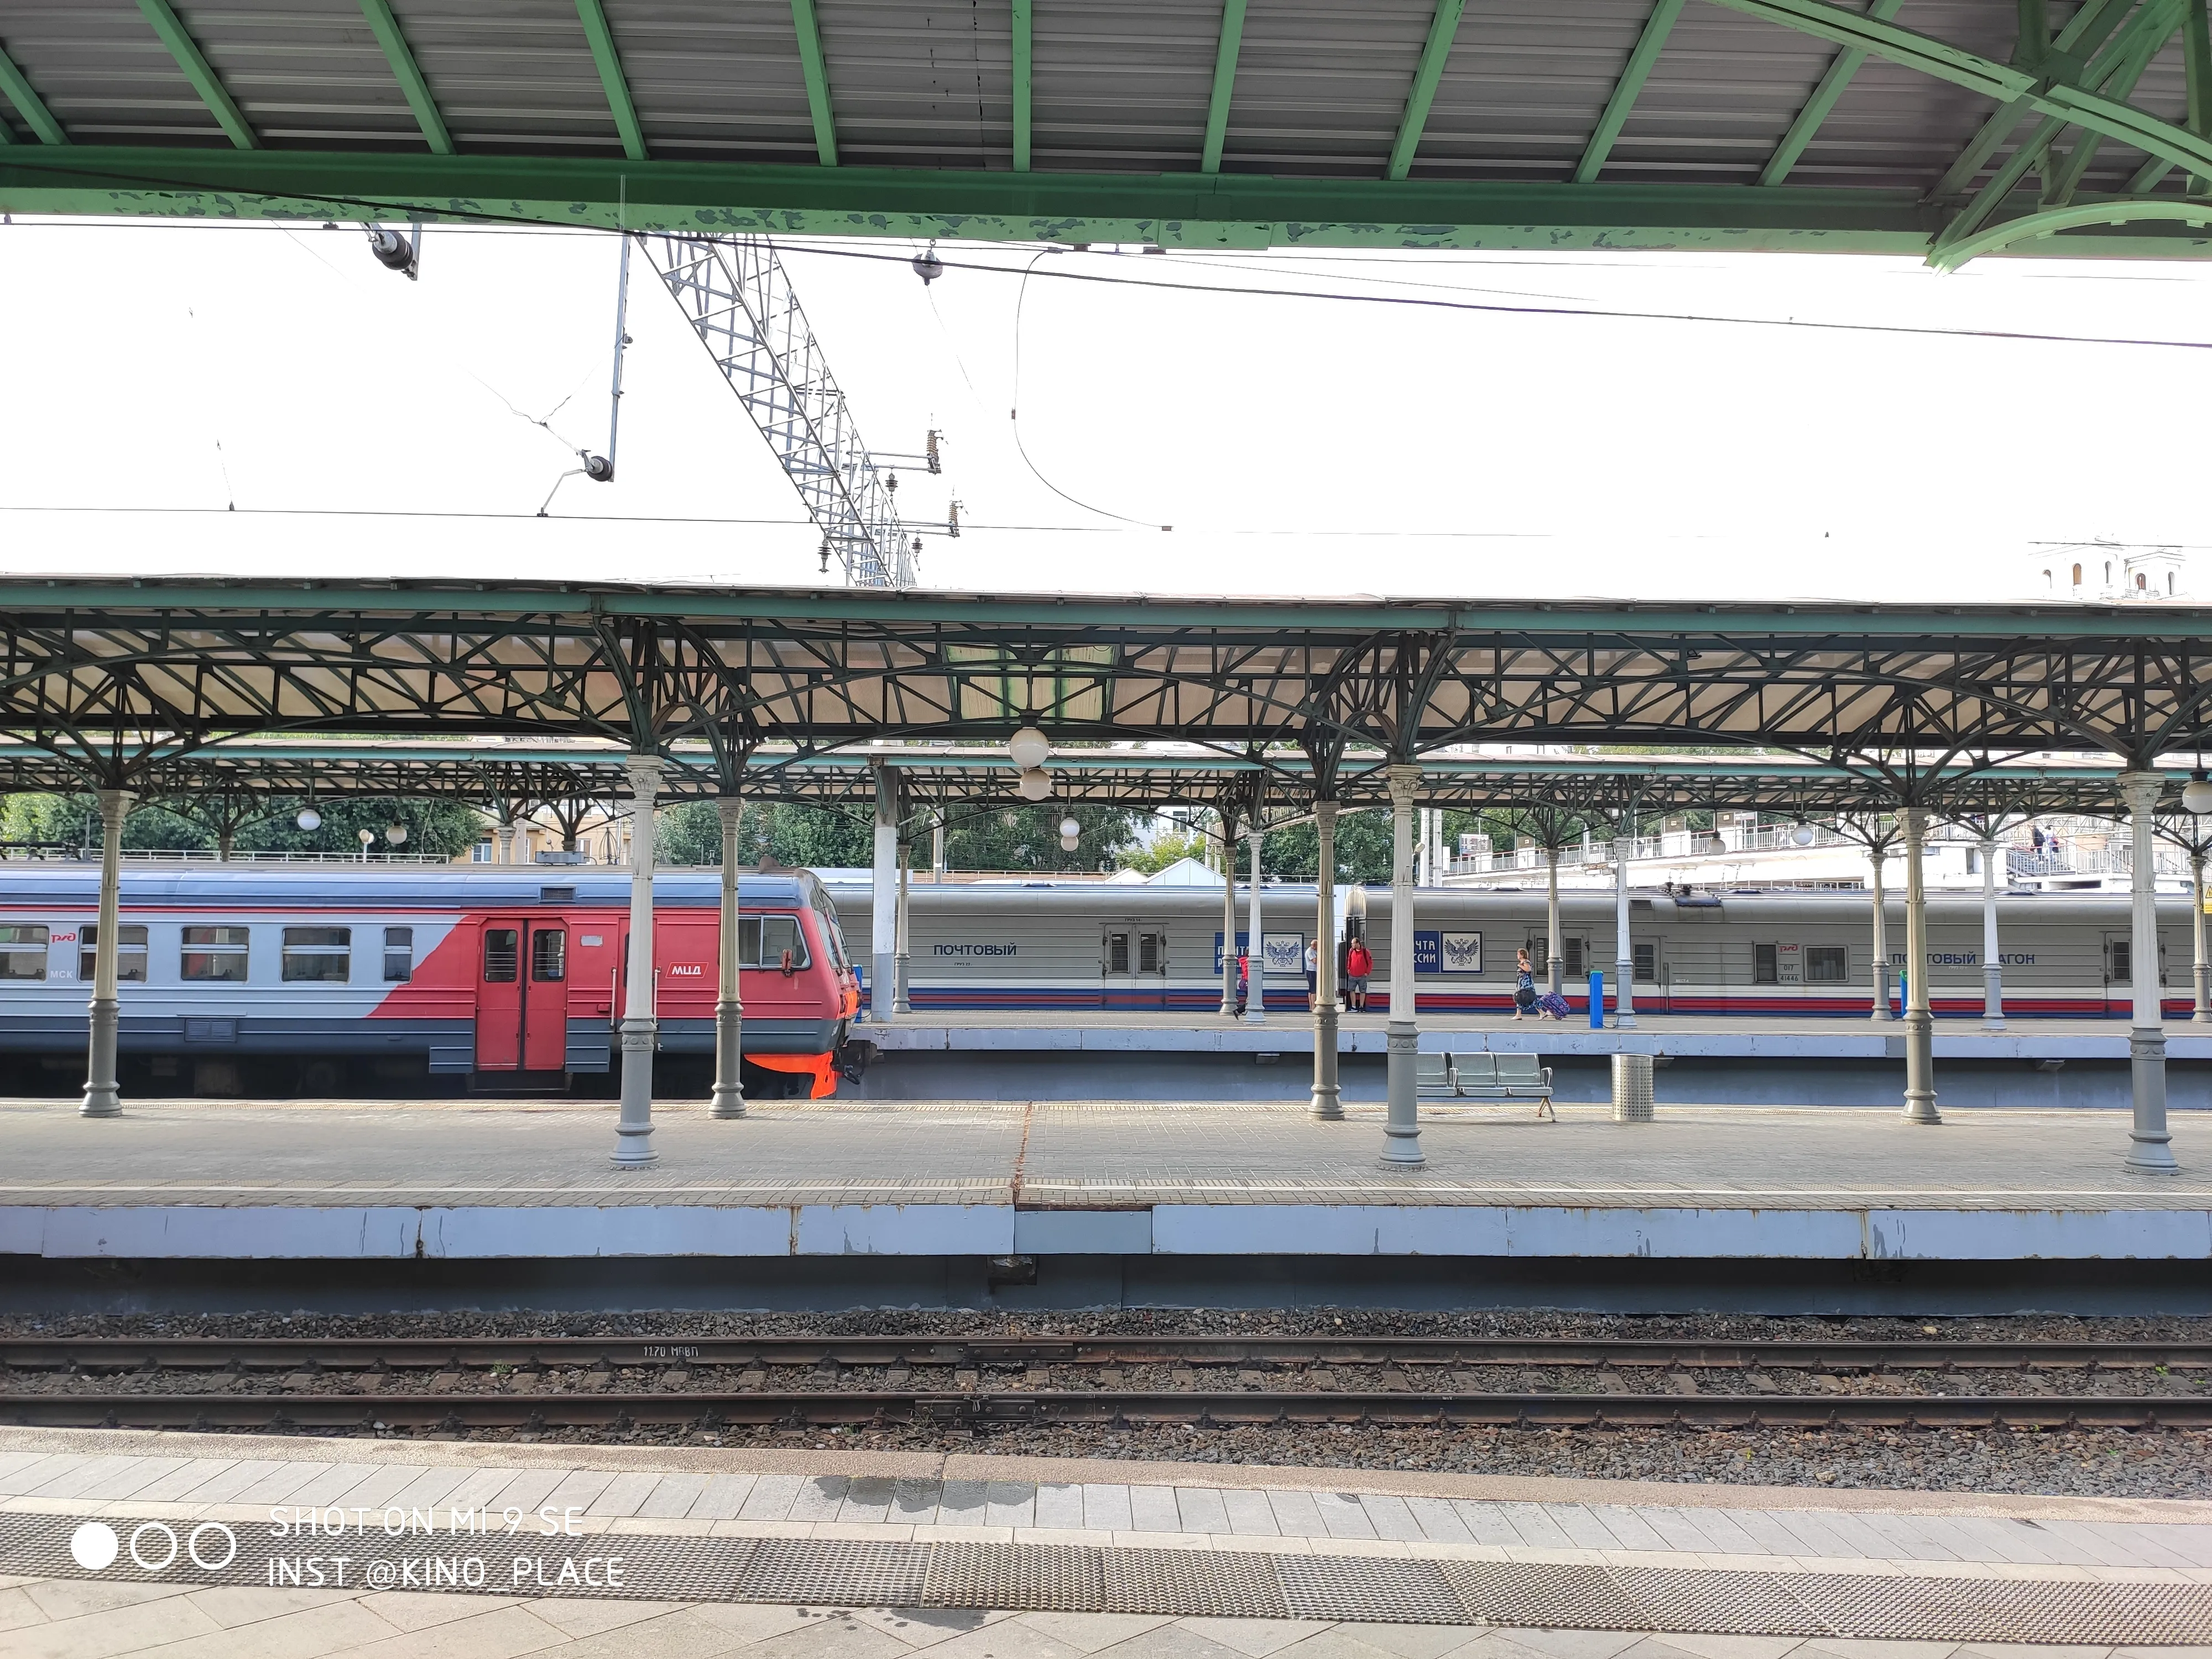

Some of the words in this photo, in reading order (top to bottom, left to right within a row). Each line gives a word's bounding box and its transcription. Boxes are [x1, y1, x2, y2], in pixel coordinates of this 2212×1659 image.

[933, 942, 1016, 956] ПОЧТОВЫЙ
[1415, 940, 1436, 950] ЧТА
[1892, 951, 1976, 964] ПТОВЫЙ
[1999, 953, 2035, 964] АГОН
[671, 966, 702, 975] МЦД
